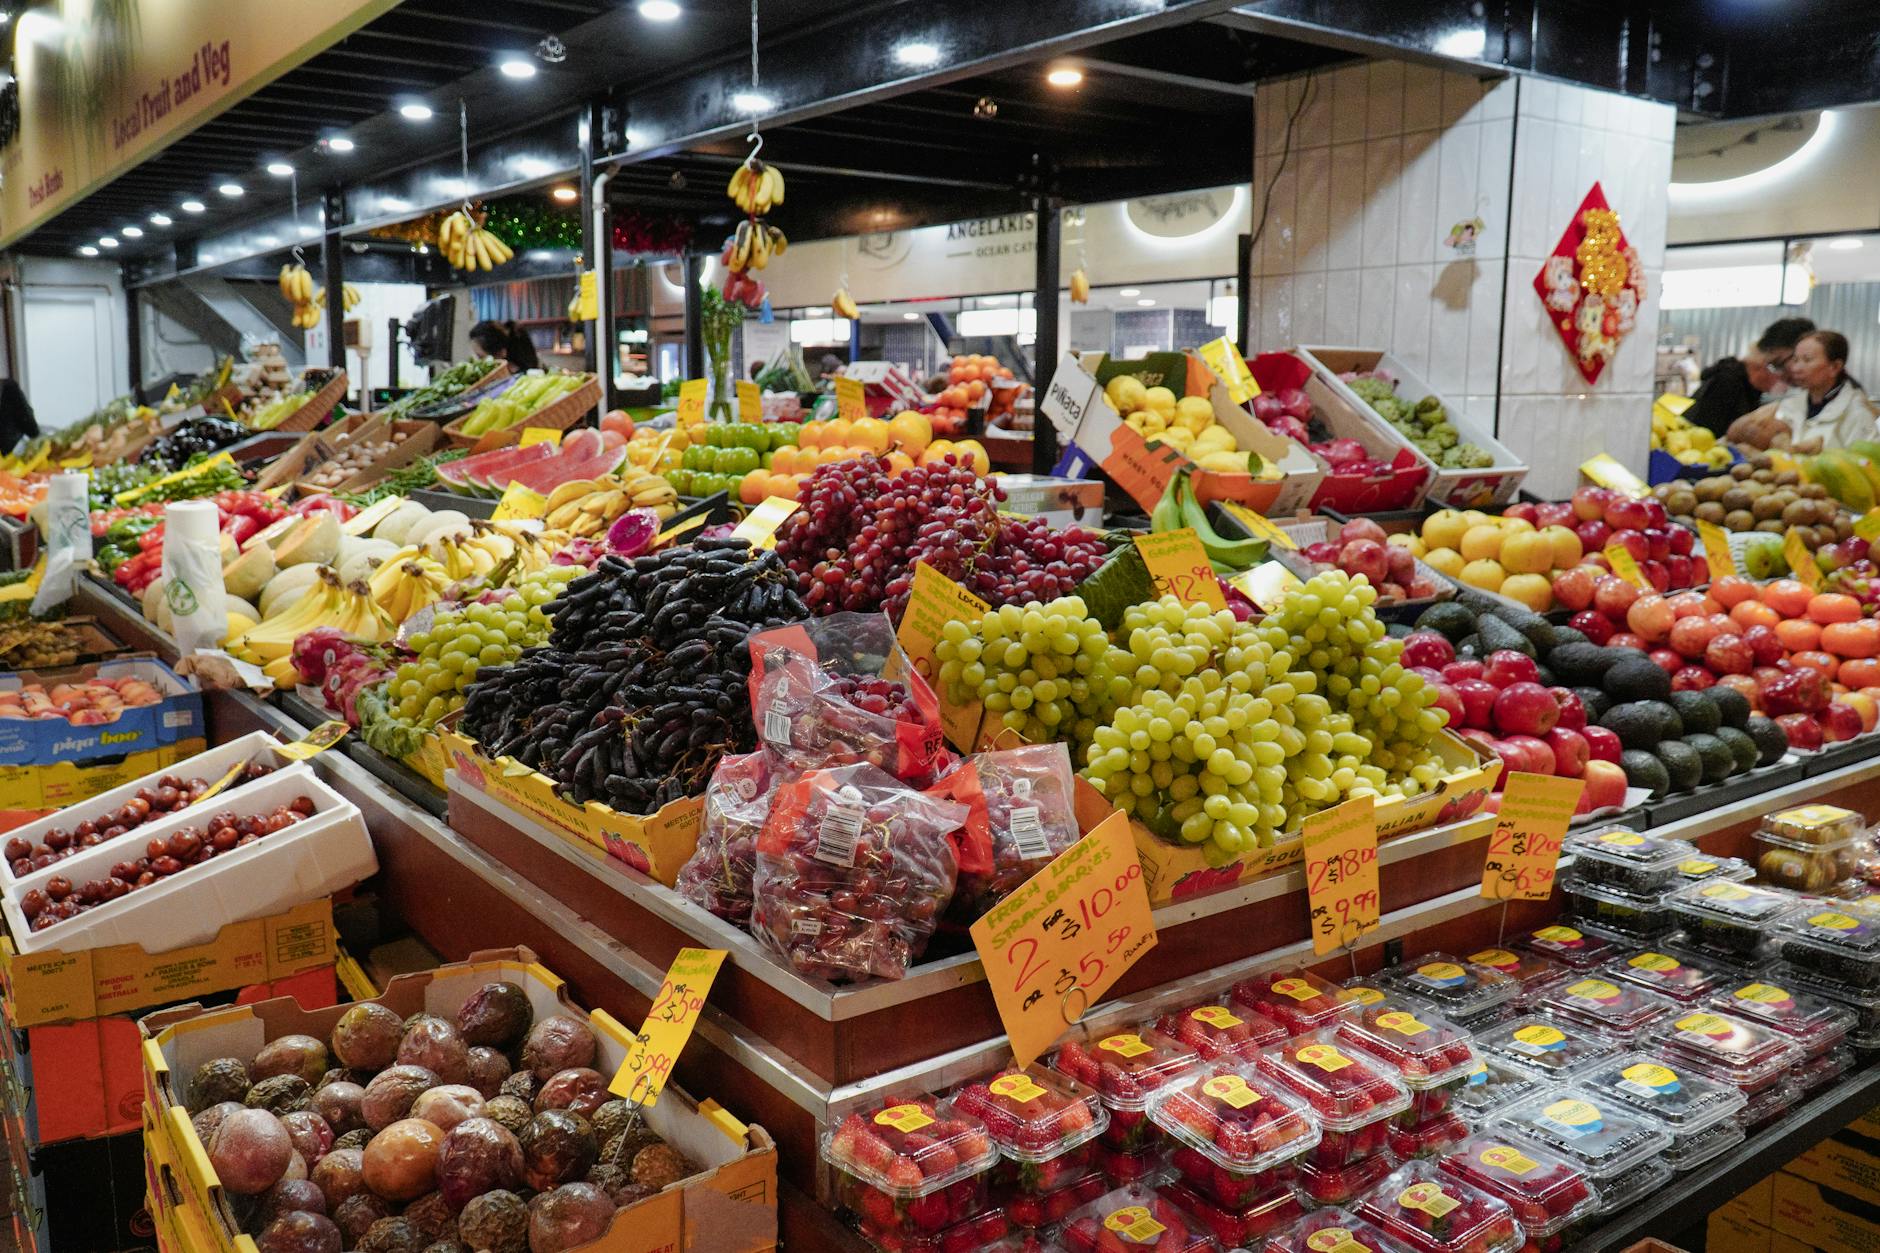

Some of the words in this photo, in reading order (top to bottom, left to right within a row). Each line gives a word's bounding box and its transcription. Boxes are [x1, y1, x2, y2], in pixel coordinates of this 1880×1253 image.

[112, 102, 141, 150] Local
[142, 76, 172, 128] Fruit
[174, 53, 201, 106] and
[201, 38, 231, 86] Veg
[946, 213, 1035, 241] ANGELAKIS
[975, 244, 1010, 258] OCEAN
[1122, 453, 1147, 478] HONEY
[958, 591, 986, 614] LOCAL
[488, 768, 520, 794] SOUTH
[524, 790, 589, 832] AUSTRALIAN
[663, 816, 688, 830] MEETS
[1265, 850, 1305, 865] SOU
[1375, 811, 1426, 833] RALIAN
[1488, 829, 1512, 855] 2
[1050, 837, 1100, 878] LOCAL
[1486, 861, 1503, 872] OR
[1308, 860, 1329, 896] 2
[1327, 854, 1341, 867] FOR
[1312, 905, 1328, 920] OR
[1008, 937, 1050, 992] 2
[1042, 908, 1064, 932] FOR
[99, 974, 135, 987] PRODUCE
[97, 987, 139, 1001] AUSTRALIA
[647, 980, 673, 1022] 2
[1022, 989, 1044, 1012] OR
[41, 1004, 65, 1014] CLASS
[636, 1033, 650, 1047] OR
